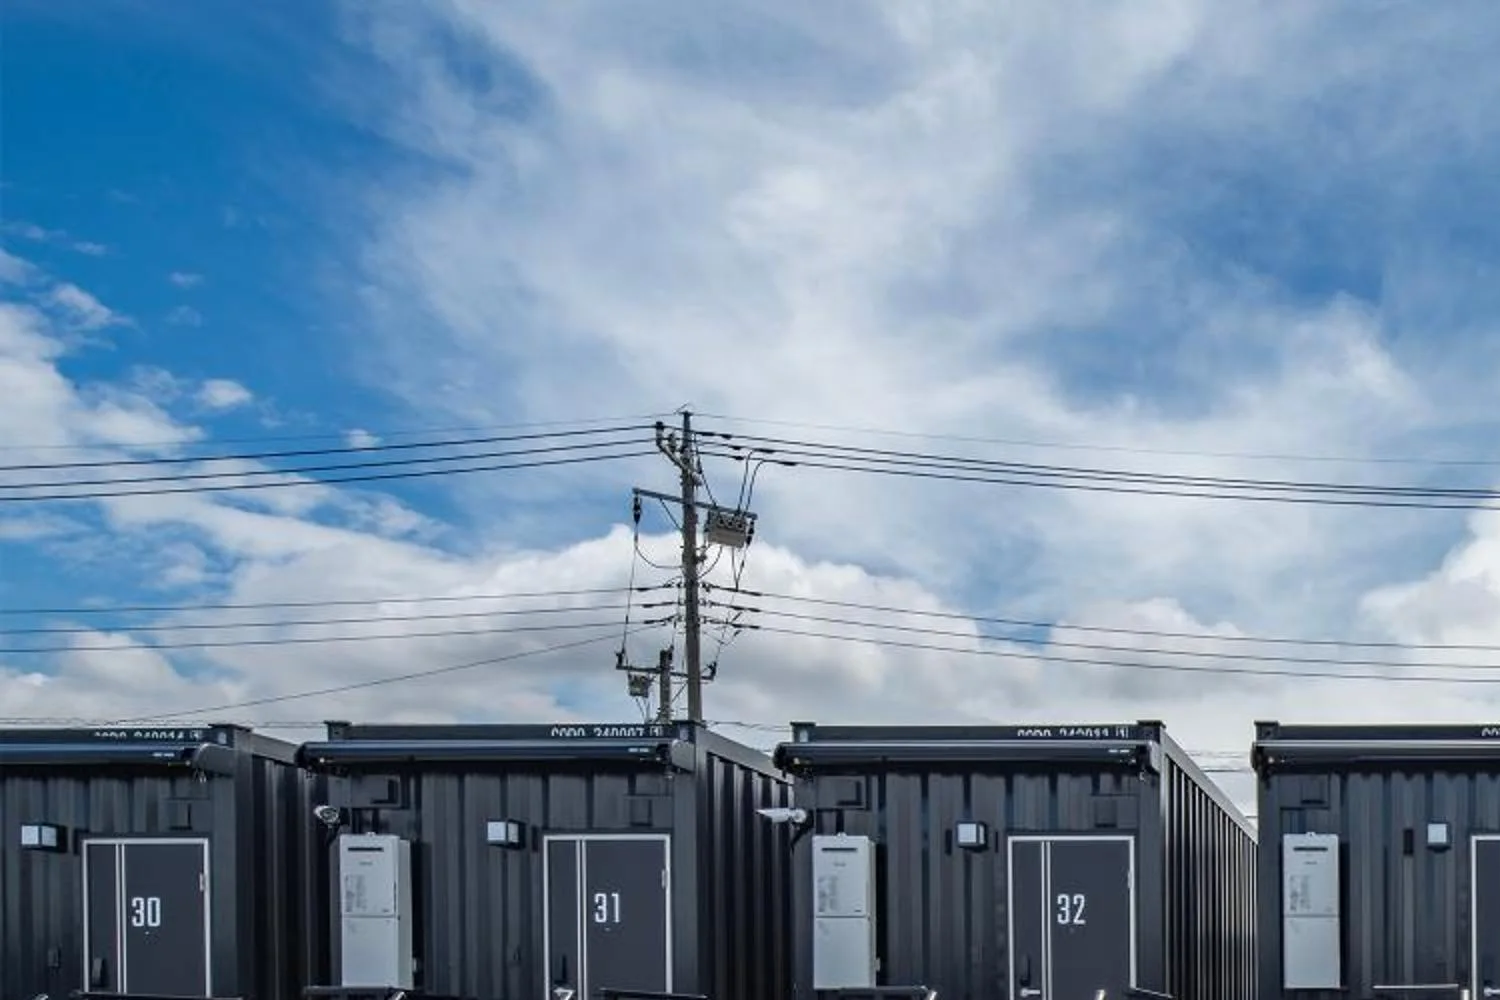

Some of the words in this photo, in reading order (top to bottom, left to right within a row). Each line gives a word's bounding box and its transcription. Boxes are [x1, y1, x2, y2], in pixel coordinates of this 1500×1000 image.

[131, 896, 161, 927] 30
[594, 892, 621, 923] 31
[1056, 893, 1086, 924] 32
